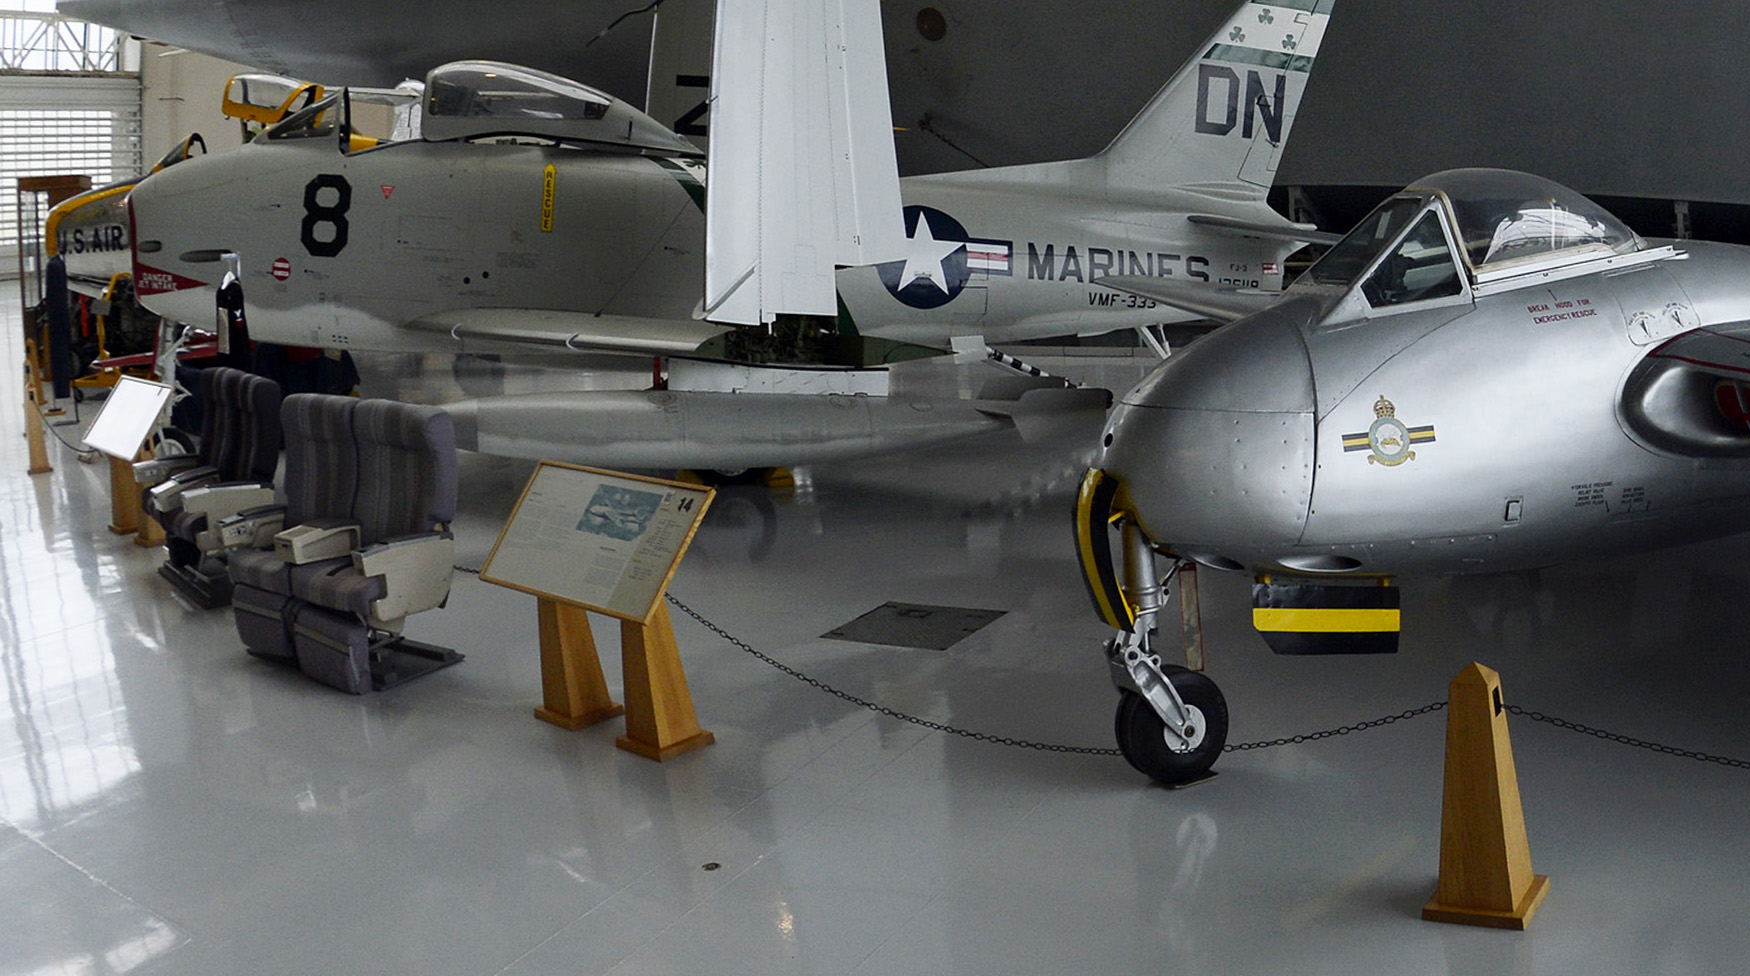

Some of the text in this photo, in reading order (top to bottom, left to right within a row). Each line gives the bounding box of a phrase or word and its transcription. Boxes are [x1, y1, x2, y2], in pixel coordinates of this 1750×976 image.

[1195, 63, 1286, 143] DN
[301, 174, 352, 257] 8
[543, 171, 553, 230] RESCUE
[1027, 242, 1210, 284] MARINES
[1089, 292, 1156, 309] VMF-333
[677, 497, 694, 513] 14
